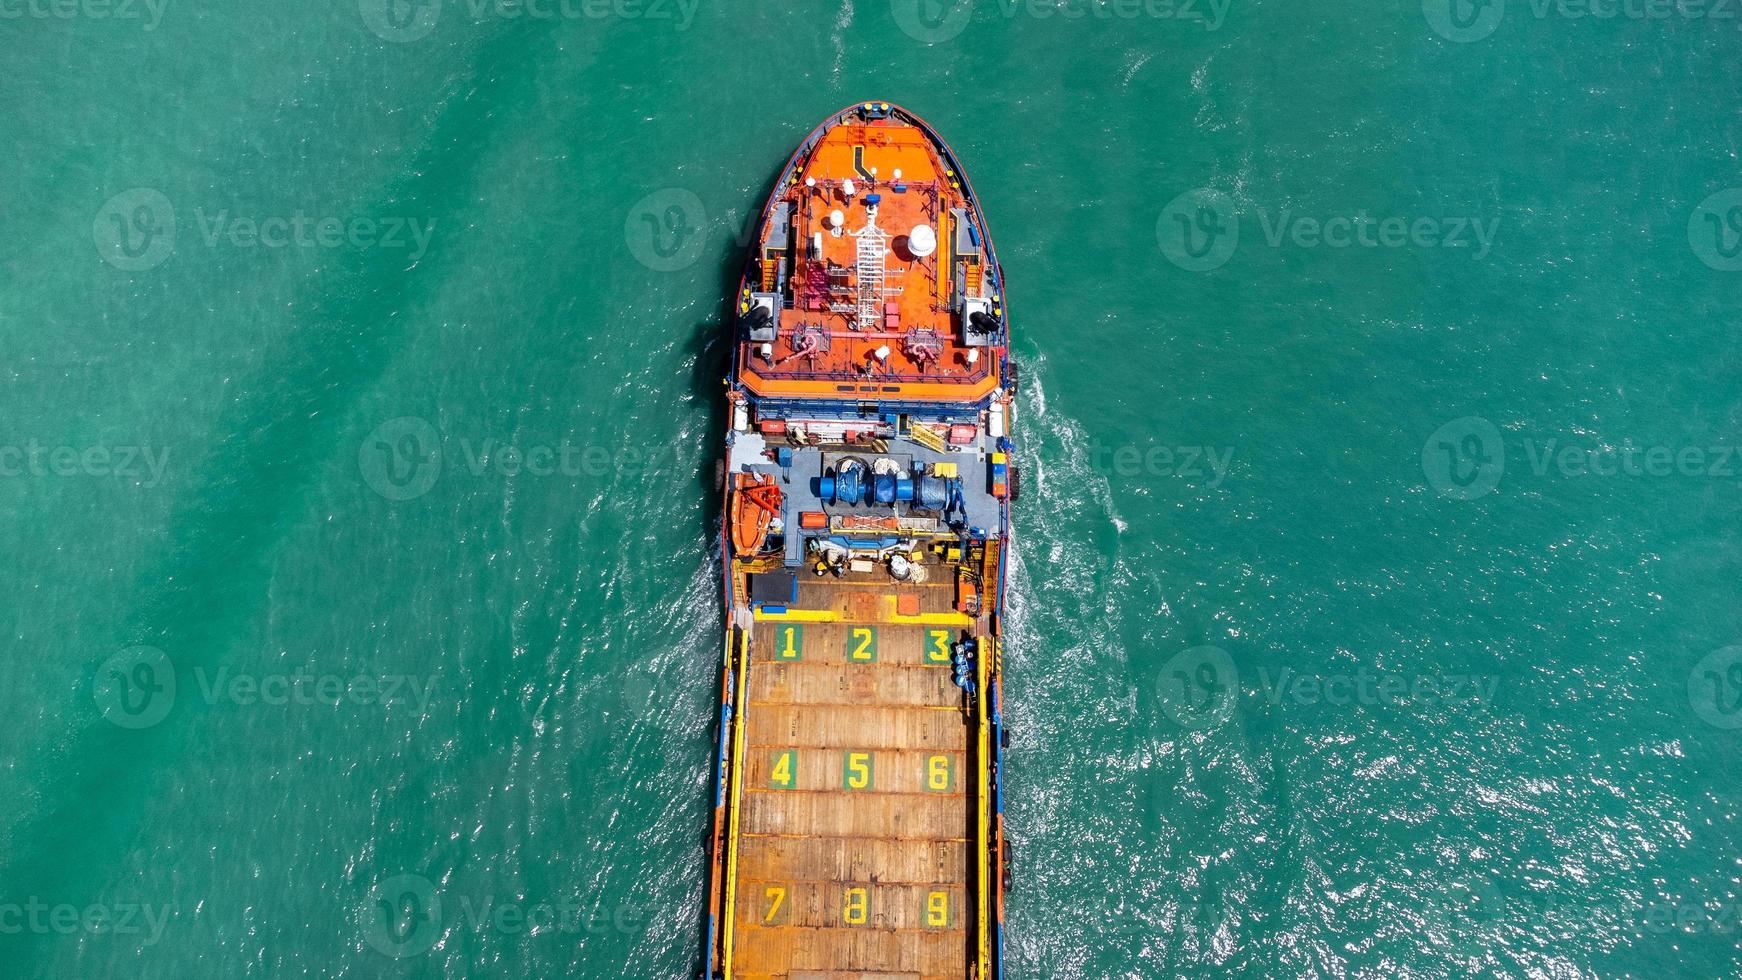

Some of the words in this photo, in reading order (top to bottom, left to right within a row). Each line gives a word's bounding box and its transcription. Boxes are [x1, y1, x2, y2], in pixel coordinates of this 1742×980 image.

[783, 628, 796, 657] 1
[853, 628, 872, 660] 2
[929, 630, 949, 661] 3
[771, 754, 791, 785] 4
[849, 753, 869, 789] 5
[928, 755, 949, 790] 6
[766, 887, 786, 921] 7
[844, 887, 868, 925] 8
[927, 892, 948, 926] 9
